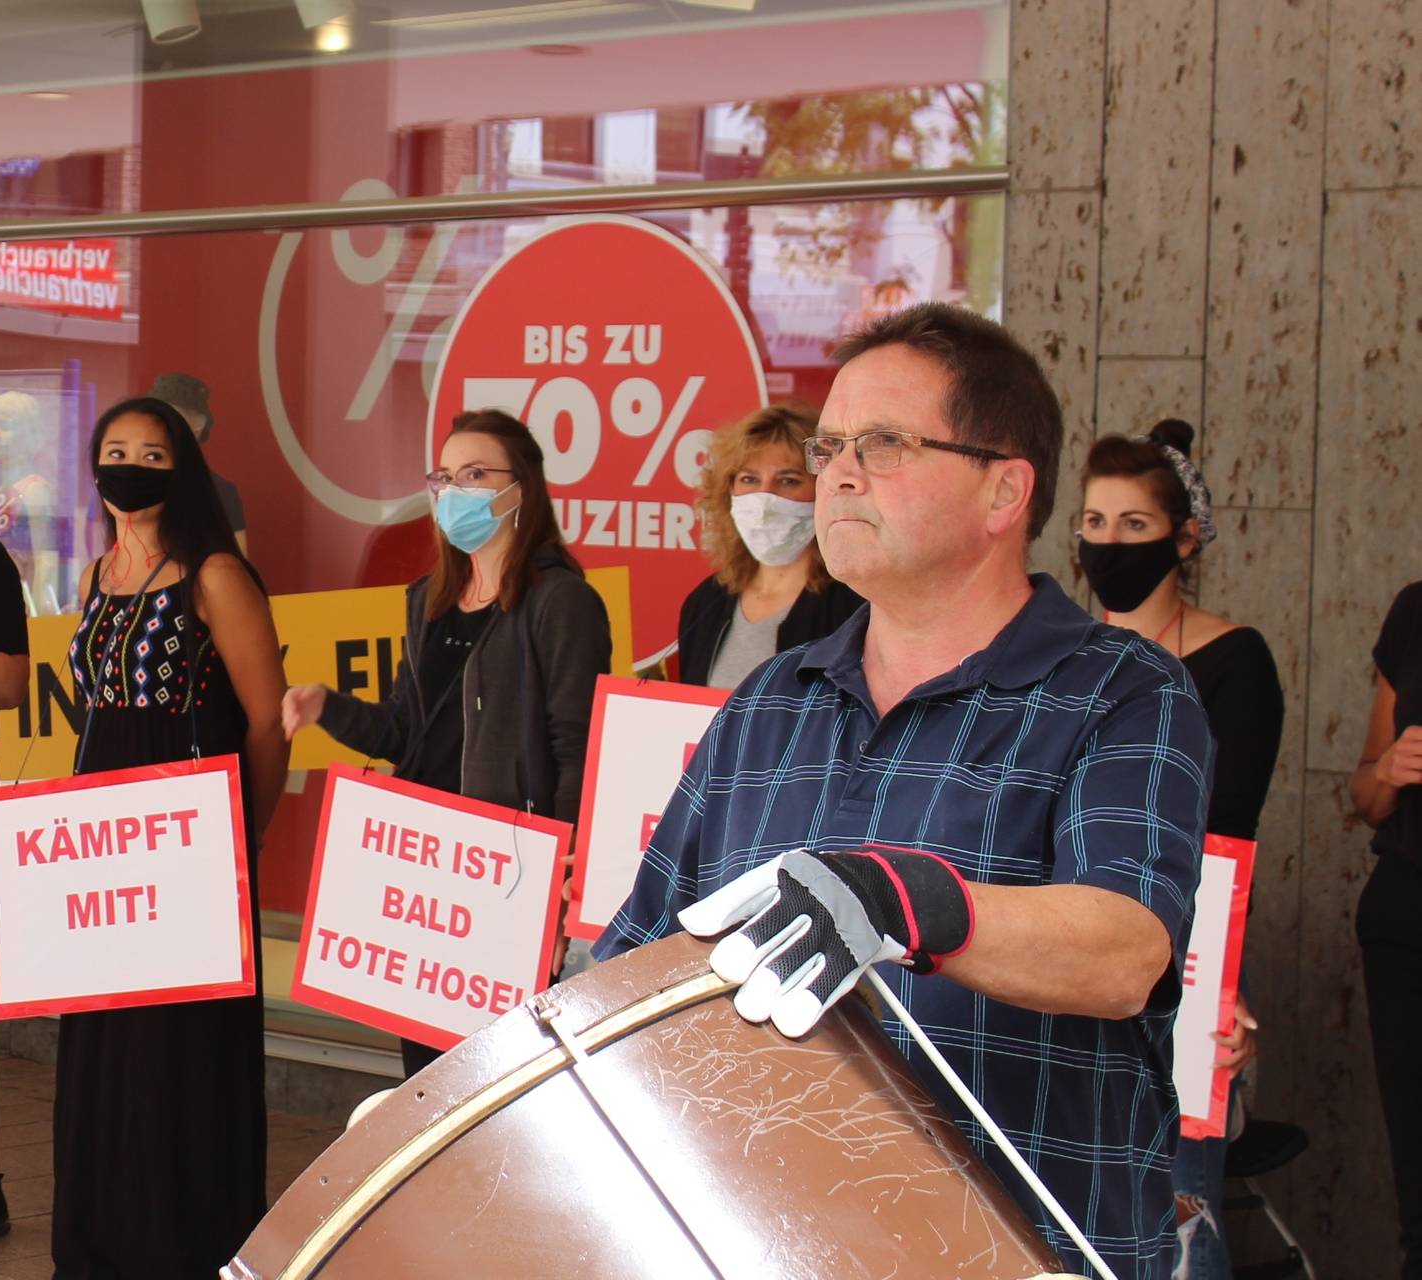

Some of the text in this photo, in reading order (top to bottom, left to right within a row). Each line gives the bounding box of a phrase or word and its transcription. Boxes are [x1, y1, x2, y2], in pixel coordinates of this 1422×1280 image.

[524, 325, 662, 364] BIS ZU
[15, 807, 200, 868] KÄMPFT
[361, 816, 513, 887] HIER IST
[65, 883, 159, 930] MIT!
[381, 884, 473, 940] BALD
[316, 926, 525, 1016] TOTE HOSE!
